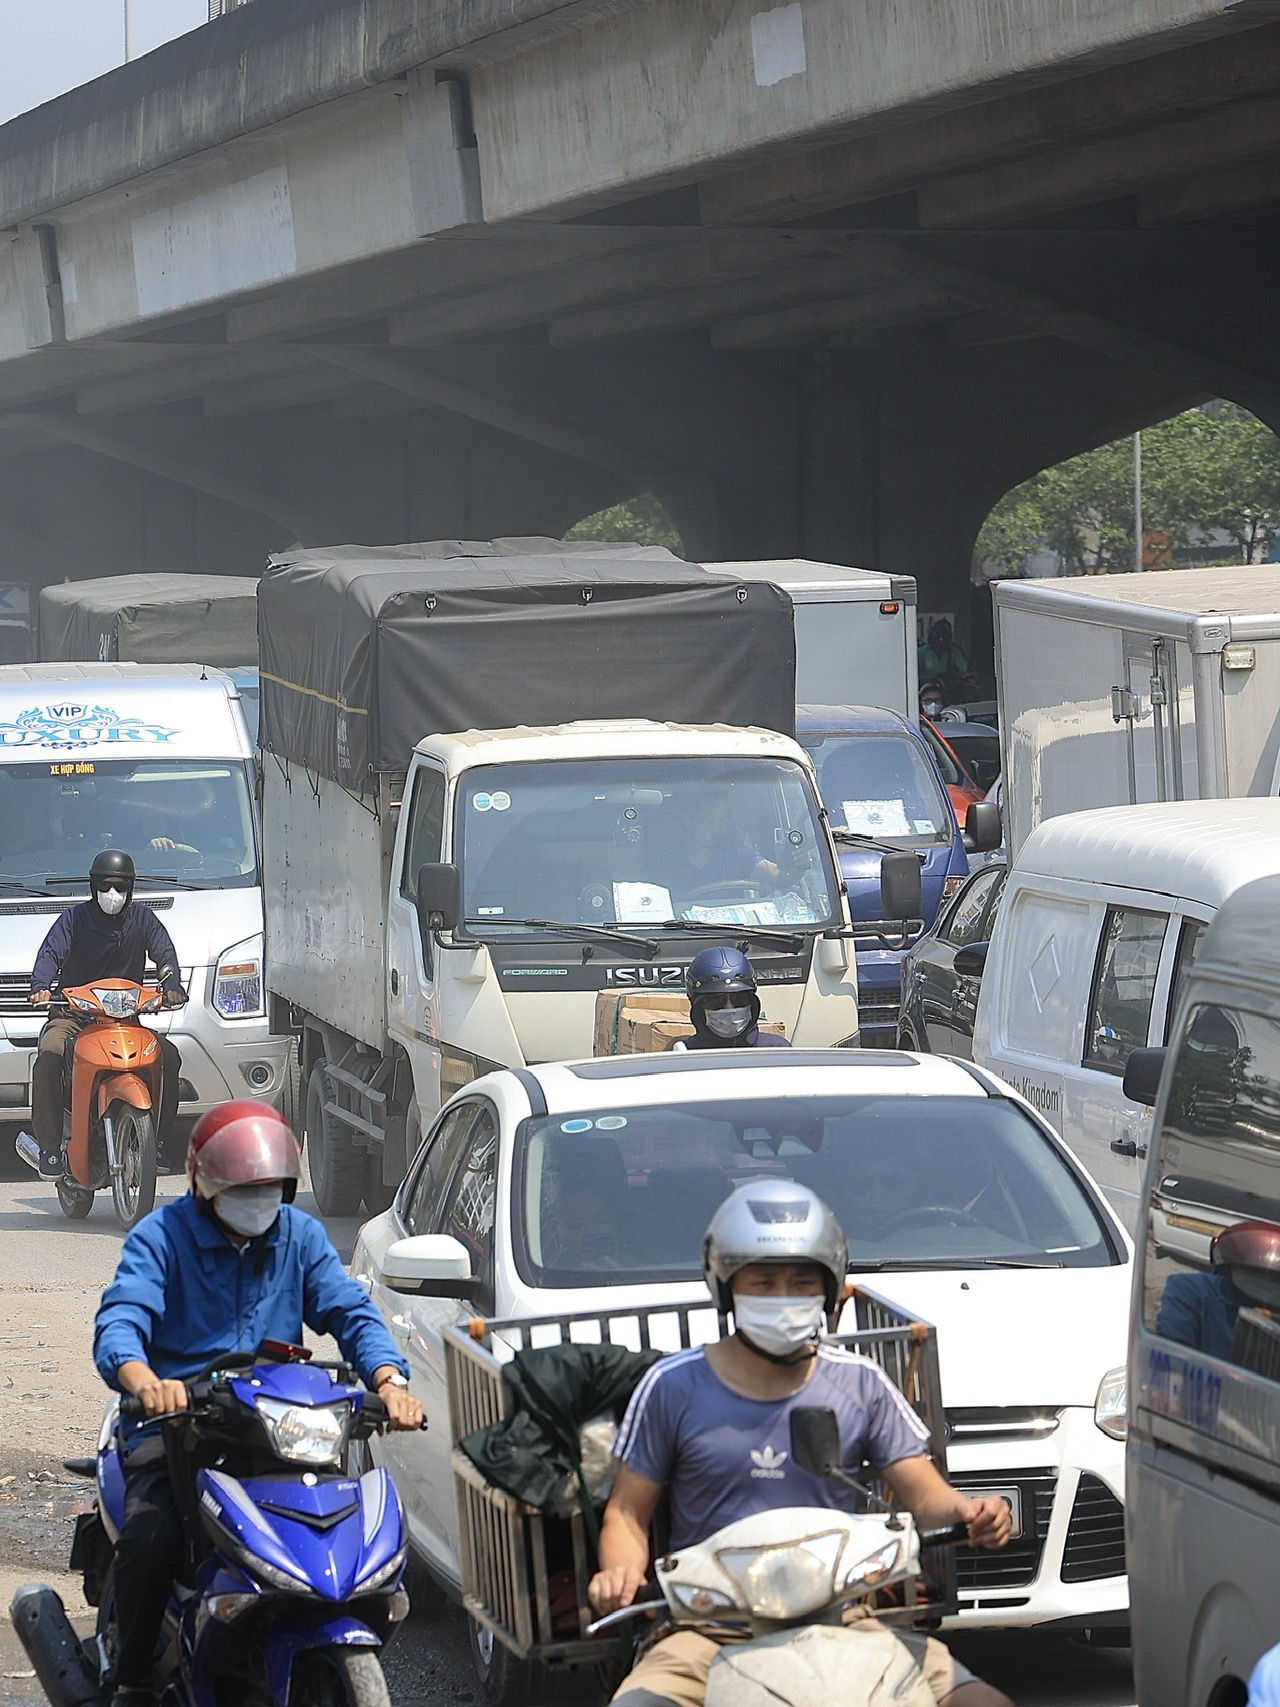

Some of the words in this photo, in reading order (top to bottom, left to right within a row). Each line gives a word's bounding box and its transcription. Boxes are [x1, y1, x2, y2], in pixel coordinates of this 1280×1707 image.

[52, 707, 82, 717] VIP
[50, 765, 60, 775] XE
[60, 764, 74, 777] HỢP
[502, 968, 568, 976] FORWARD
[606, 967, 689, 987] ISUZ
[750, 1469, 786, 1480] adidas
